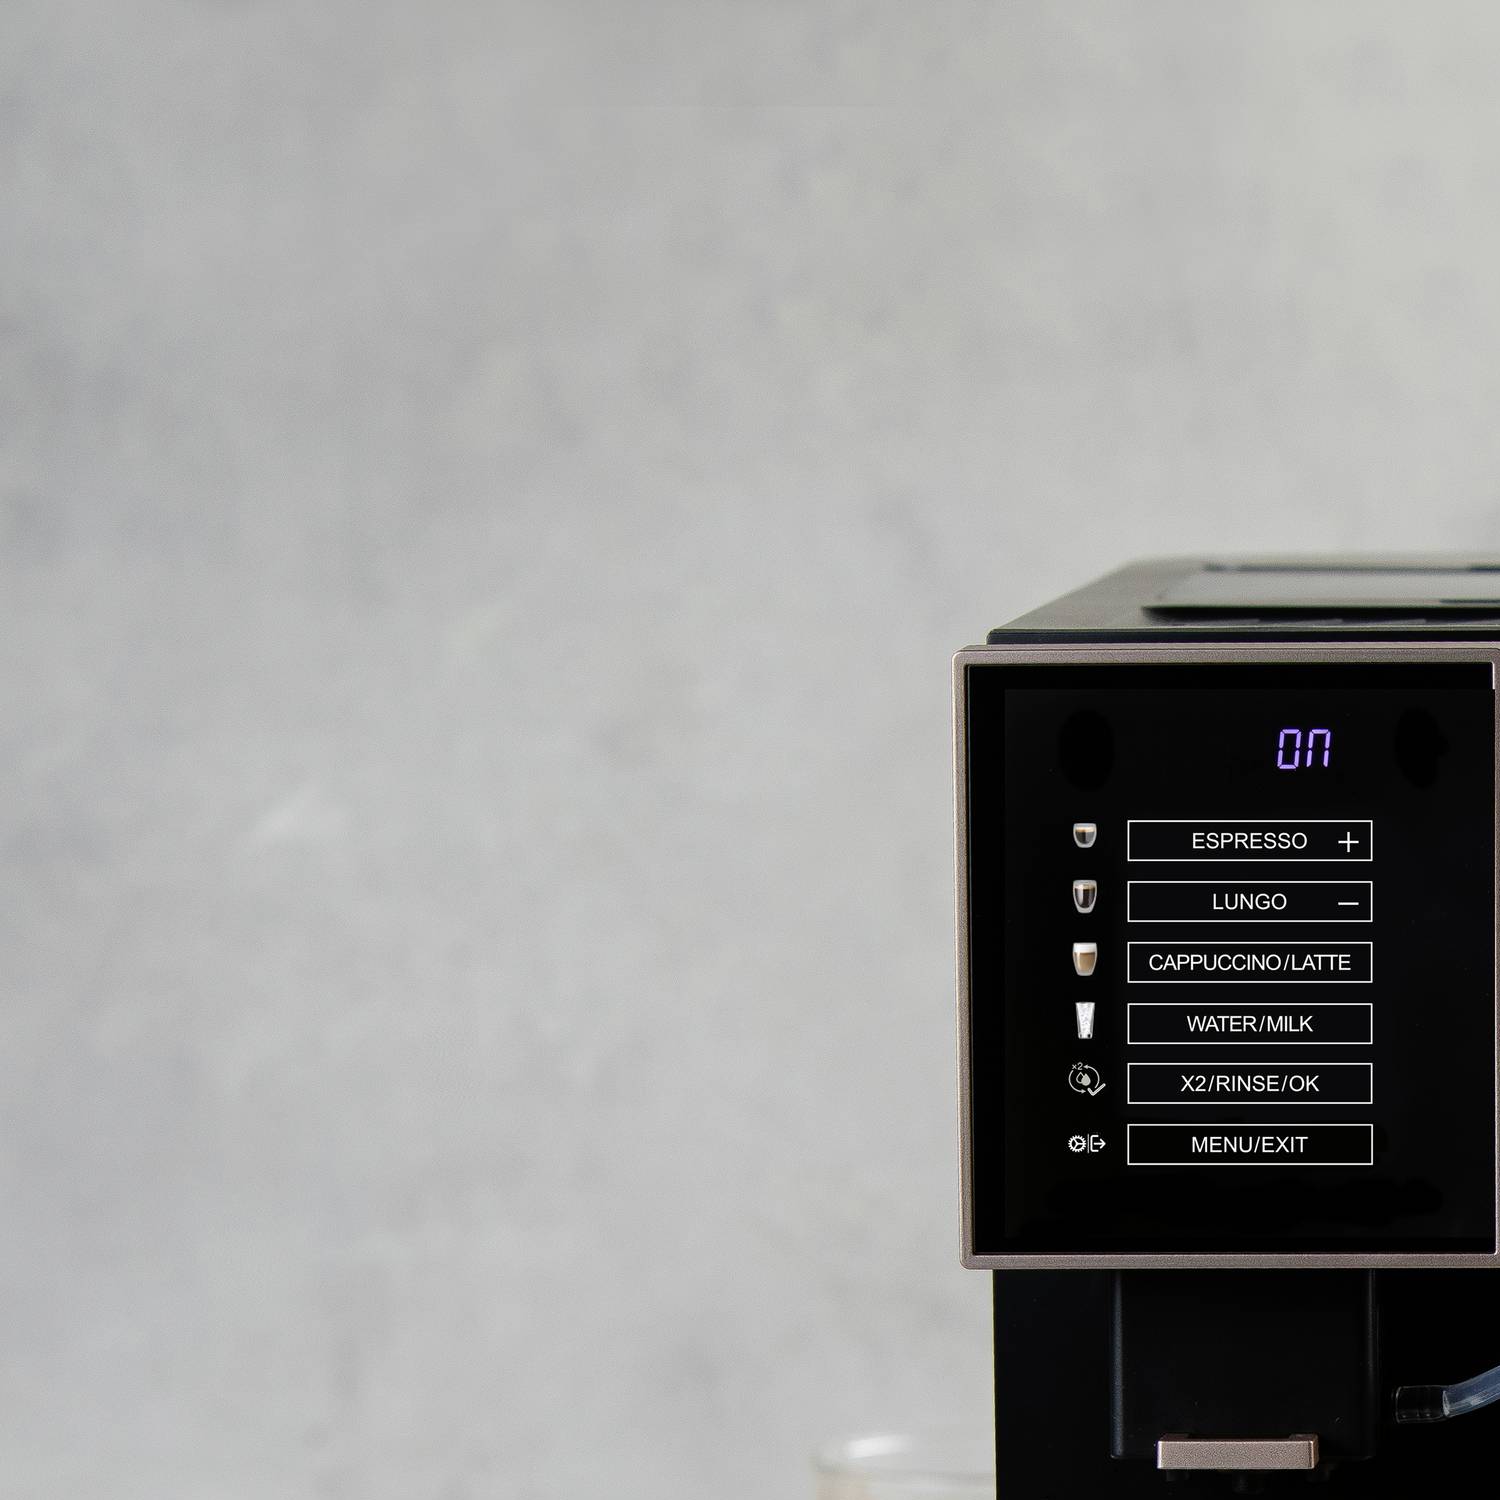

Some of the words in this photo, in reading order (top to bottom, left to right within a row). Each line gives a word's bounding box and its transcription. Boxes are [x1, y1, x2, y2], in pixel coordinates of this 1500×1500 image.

[1192, 832, 1308, 850] ESPRESSO
[1213, 893, 1288, 911] LUNGO
[1148, 953, 1352, 971] CAPPUCCINO/LATTE
[1186, 1015, 1314, 1033] WATER/MILK
[1180, 1074, 1320, 1093] X2/RINSE/OK
[1191, 1135, 1309, 1153] MENU/EXIT
